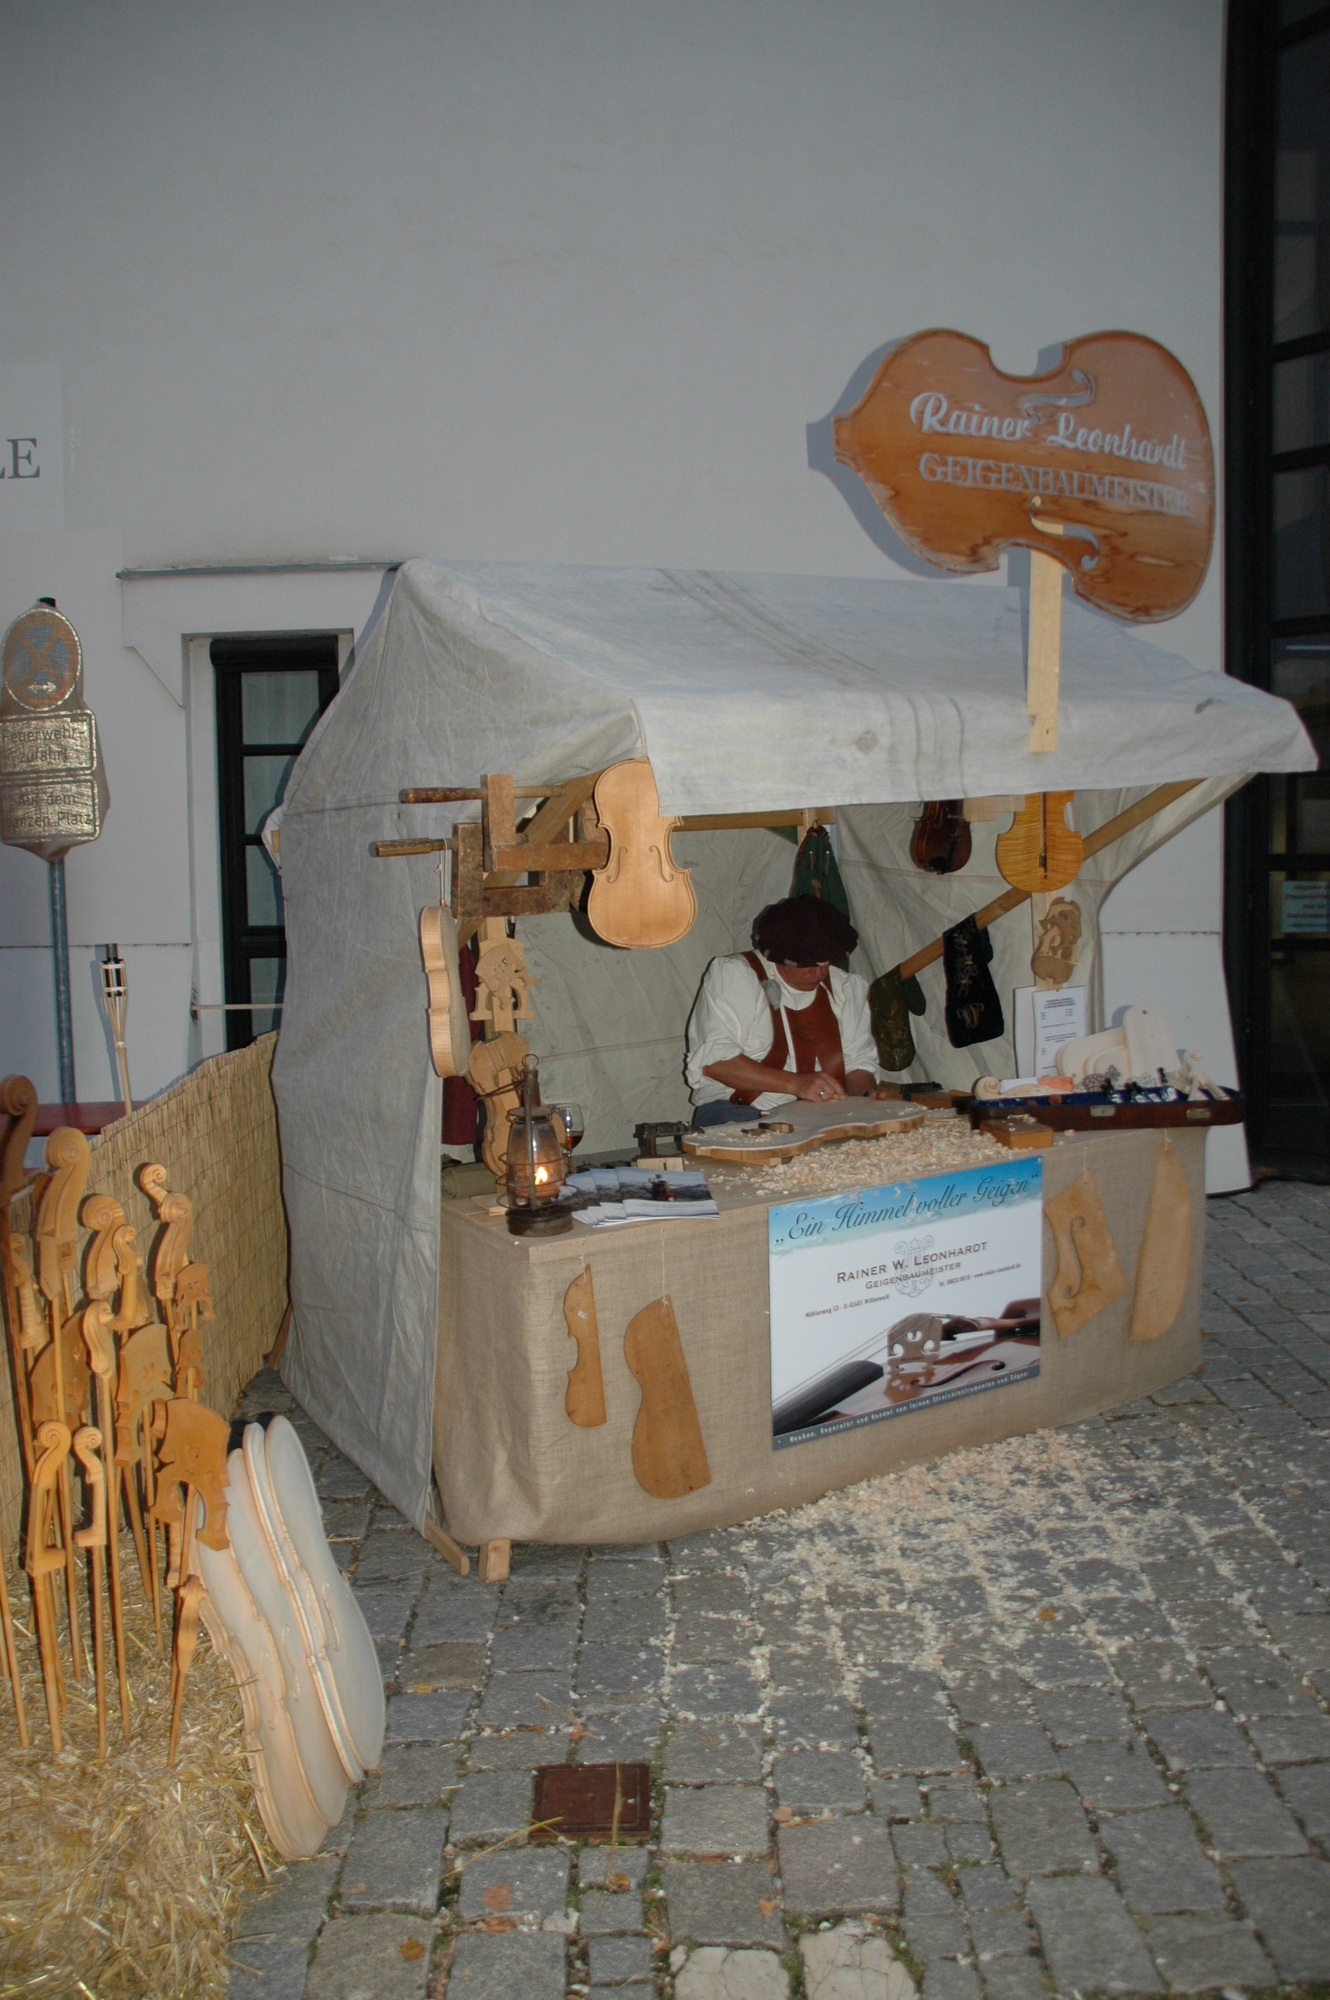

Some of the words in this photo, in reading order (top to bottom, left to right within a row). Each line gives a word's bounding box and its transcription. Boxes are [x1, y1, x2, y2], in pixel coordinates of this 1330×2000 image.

[910, 392, 1033, 440] Rainer
[1047, 413, 1187, 470] Leonhardt
[0, 437, 41, 479] E
[919, 452, 1191, 516] GEIGENBAUMEISTER
[47, 791, 76, 806] dem
[58, 811, 92, 826] Platz
[832, 1192, 915, 1231] Himmel
[916, 1184, 968, 1214] voller
[837, 1264, 887, 1284] RAINER
[892, 1258, 909, 1271] W.
[914, 1241, 988, 1267] LEONHARDT
[865, 1262, 961, 1290] GEIGENBAUMEISTER
